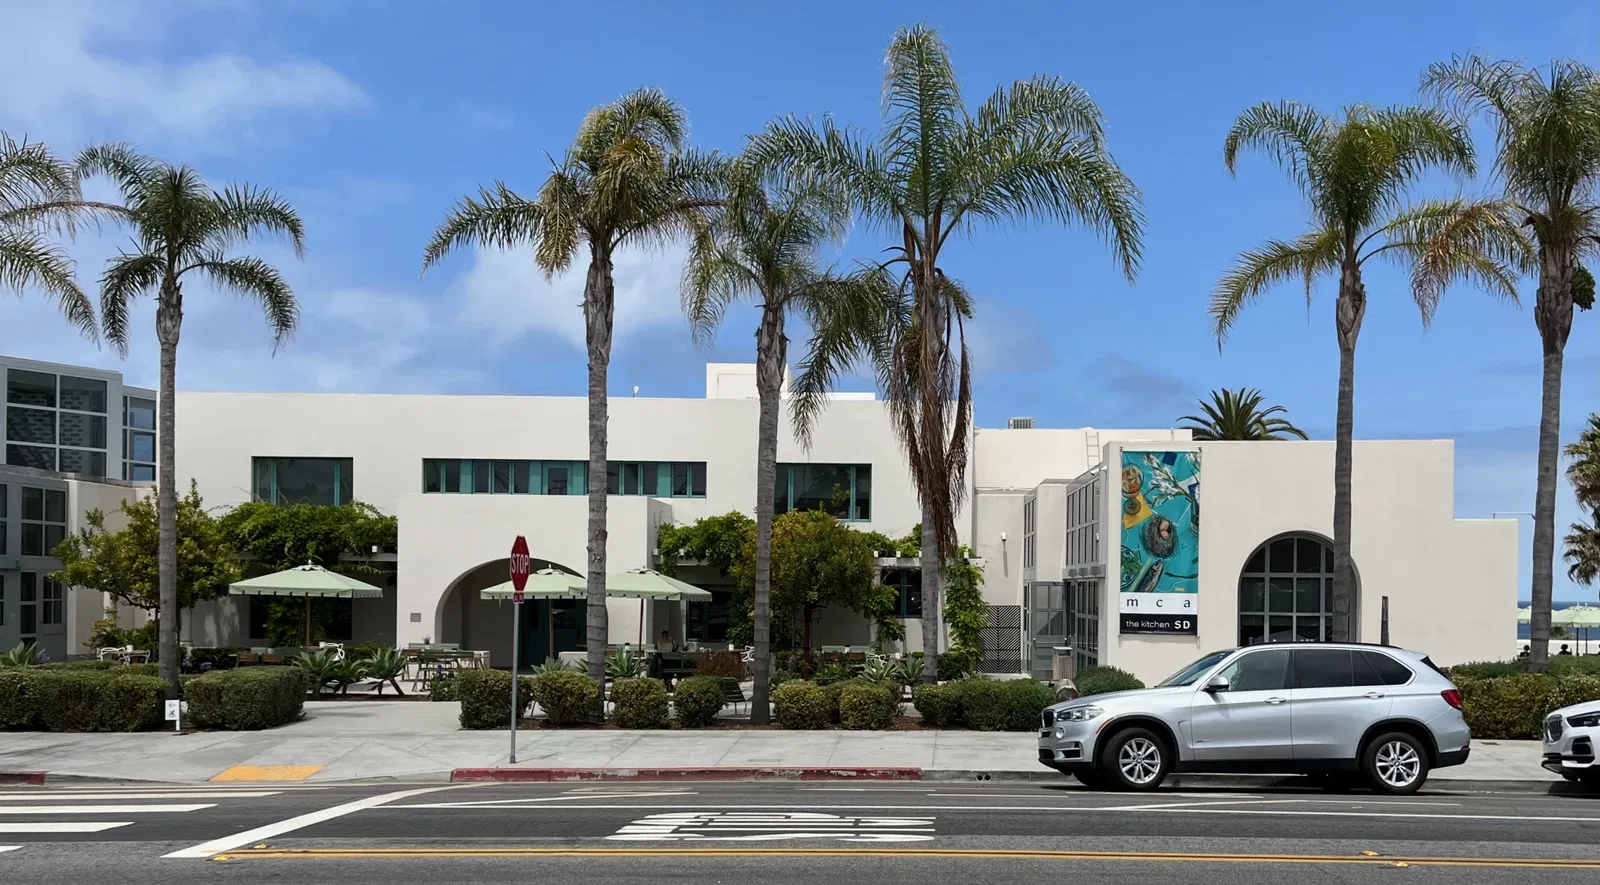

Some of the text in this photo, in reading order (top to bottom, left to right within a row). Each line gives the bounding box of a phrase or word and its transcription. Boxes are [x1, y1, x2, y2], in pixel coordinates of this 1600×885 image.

[511, 553, 529, 574] STOP
[1125, 620, 1191, 629] the kitchen SD
